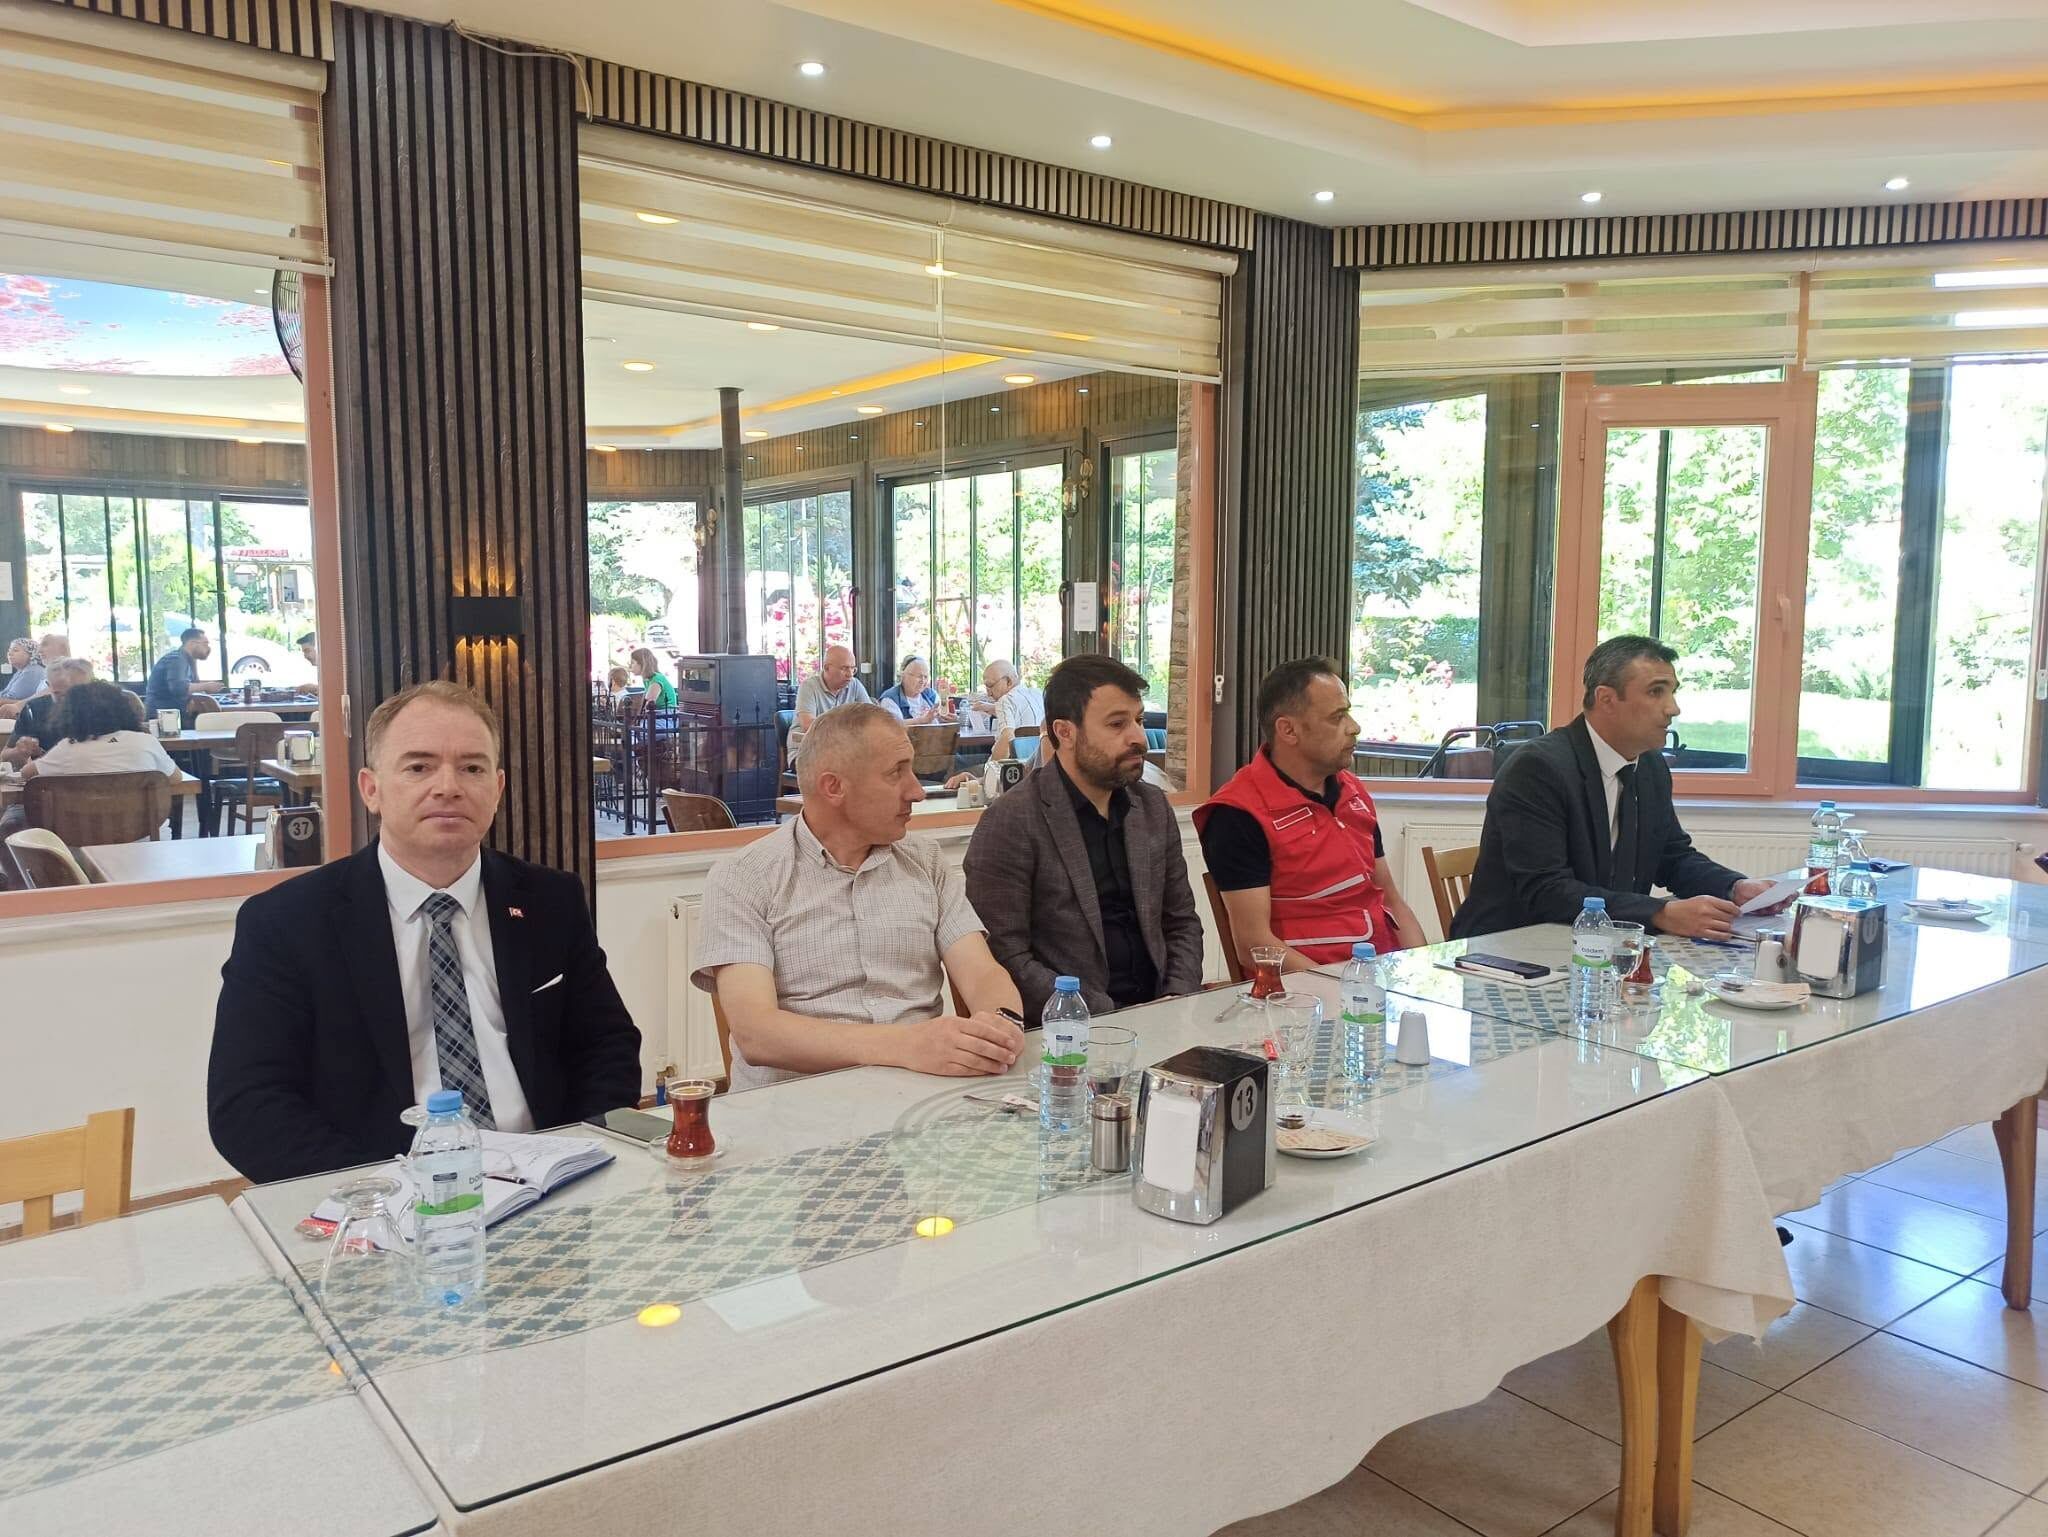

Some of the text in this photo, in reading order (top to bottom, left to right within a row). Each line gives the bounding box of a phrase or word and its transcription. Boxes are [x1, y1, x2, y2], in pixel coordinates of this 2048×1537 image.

[1008, 769, 1018, 780] 36
[293, 821, 309, 836] 37
[1236, 1084, 1253, 1121] 13
